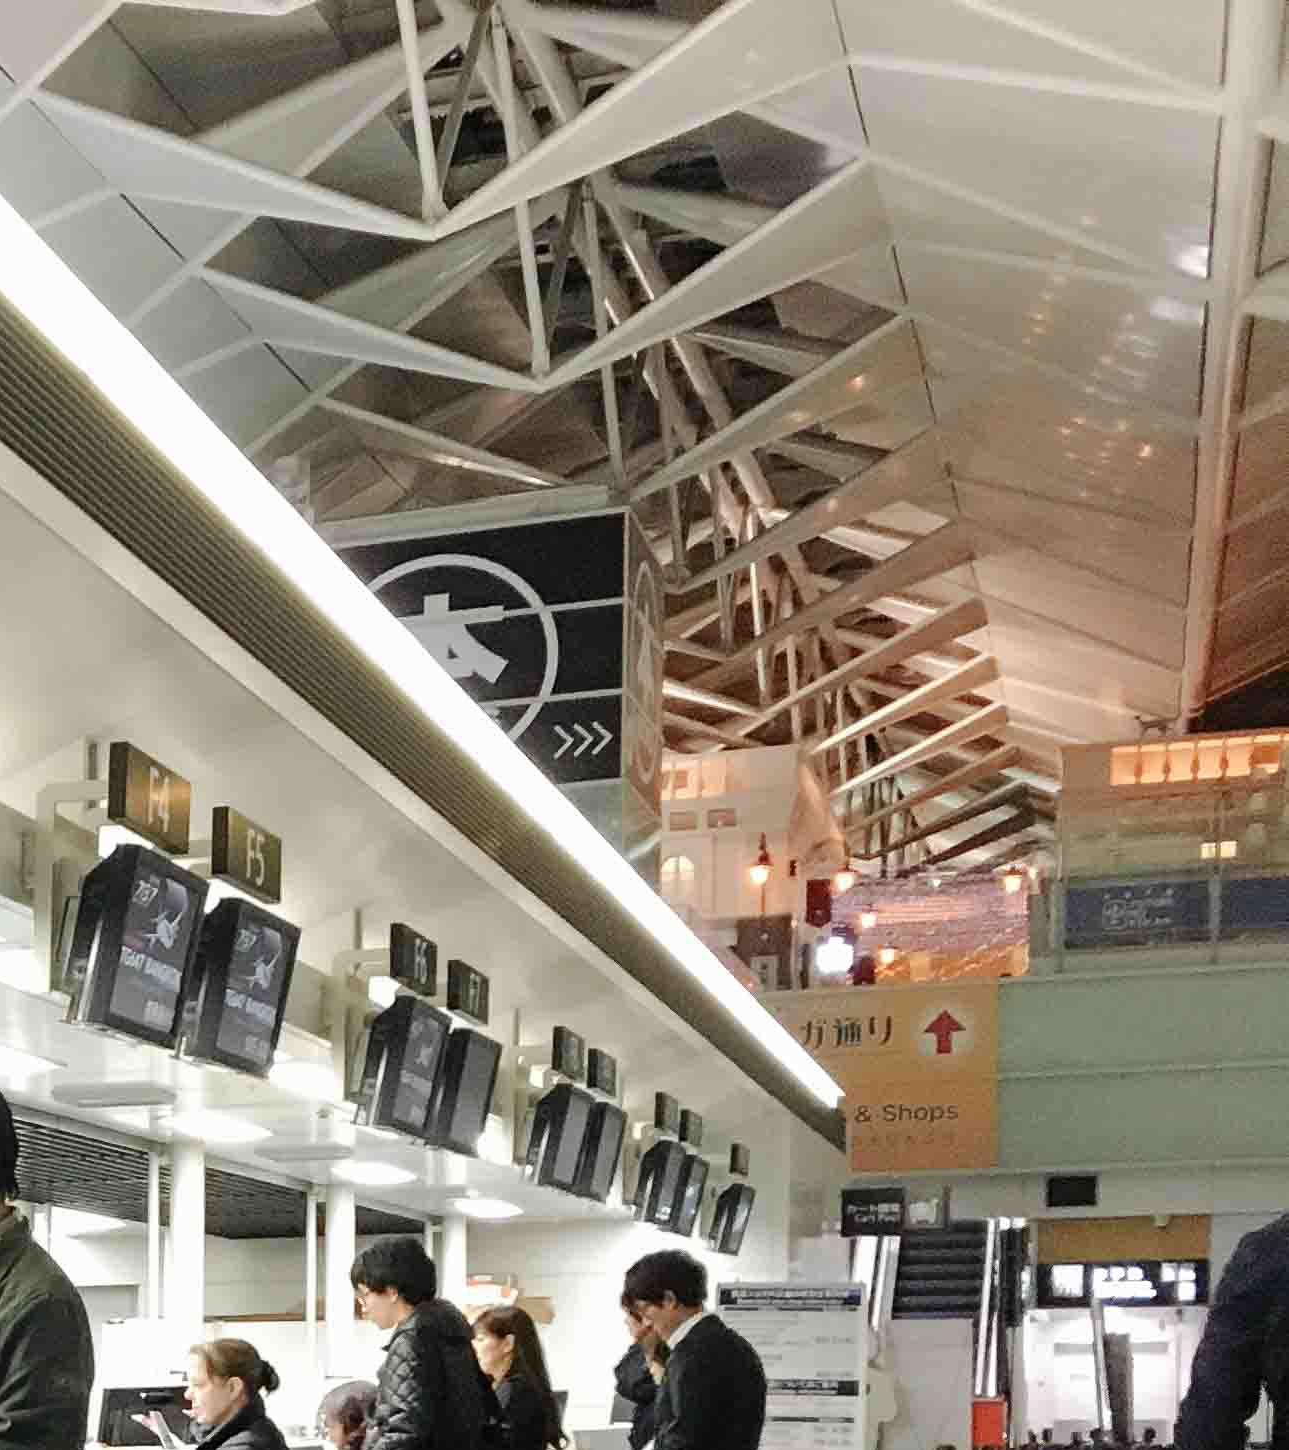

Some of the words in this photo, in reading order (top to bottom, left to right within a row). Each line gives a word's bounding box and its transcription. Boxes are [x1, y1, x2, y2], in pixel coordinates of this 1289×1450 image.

[146, 765, 170, 833] F4
[245, 827, 265, 887] F5
[854, 1105, 872, 1123] &
[882, 1103, 960, 1124] Shops
